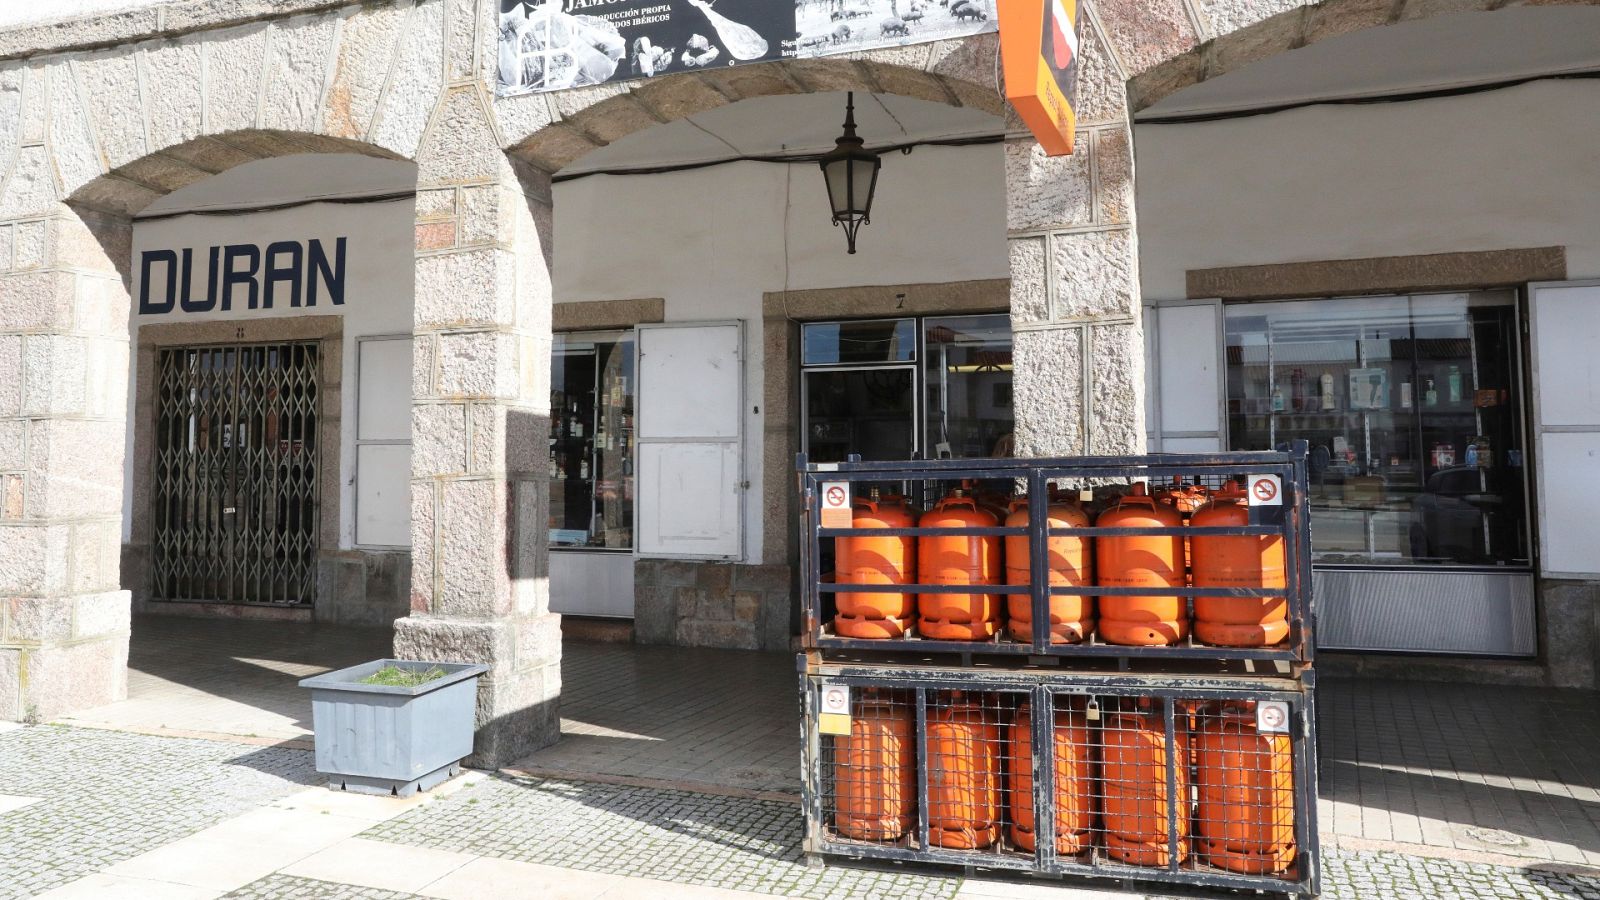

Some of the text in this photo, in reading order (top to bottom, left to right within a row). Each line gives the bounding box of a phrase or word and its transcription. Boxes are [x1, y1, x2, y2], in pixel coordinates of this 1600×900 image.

[641, 4, 672, 15] PROPIA
[632, 13, 670, 26] IBÉRICOS
[139, 237, 347, 315] DURAN
[895, 293, 905, 309] 7
